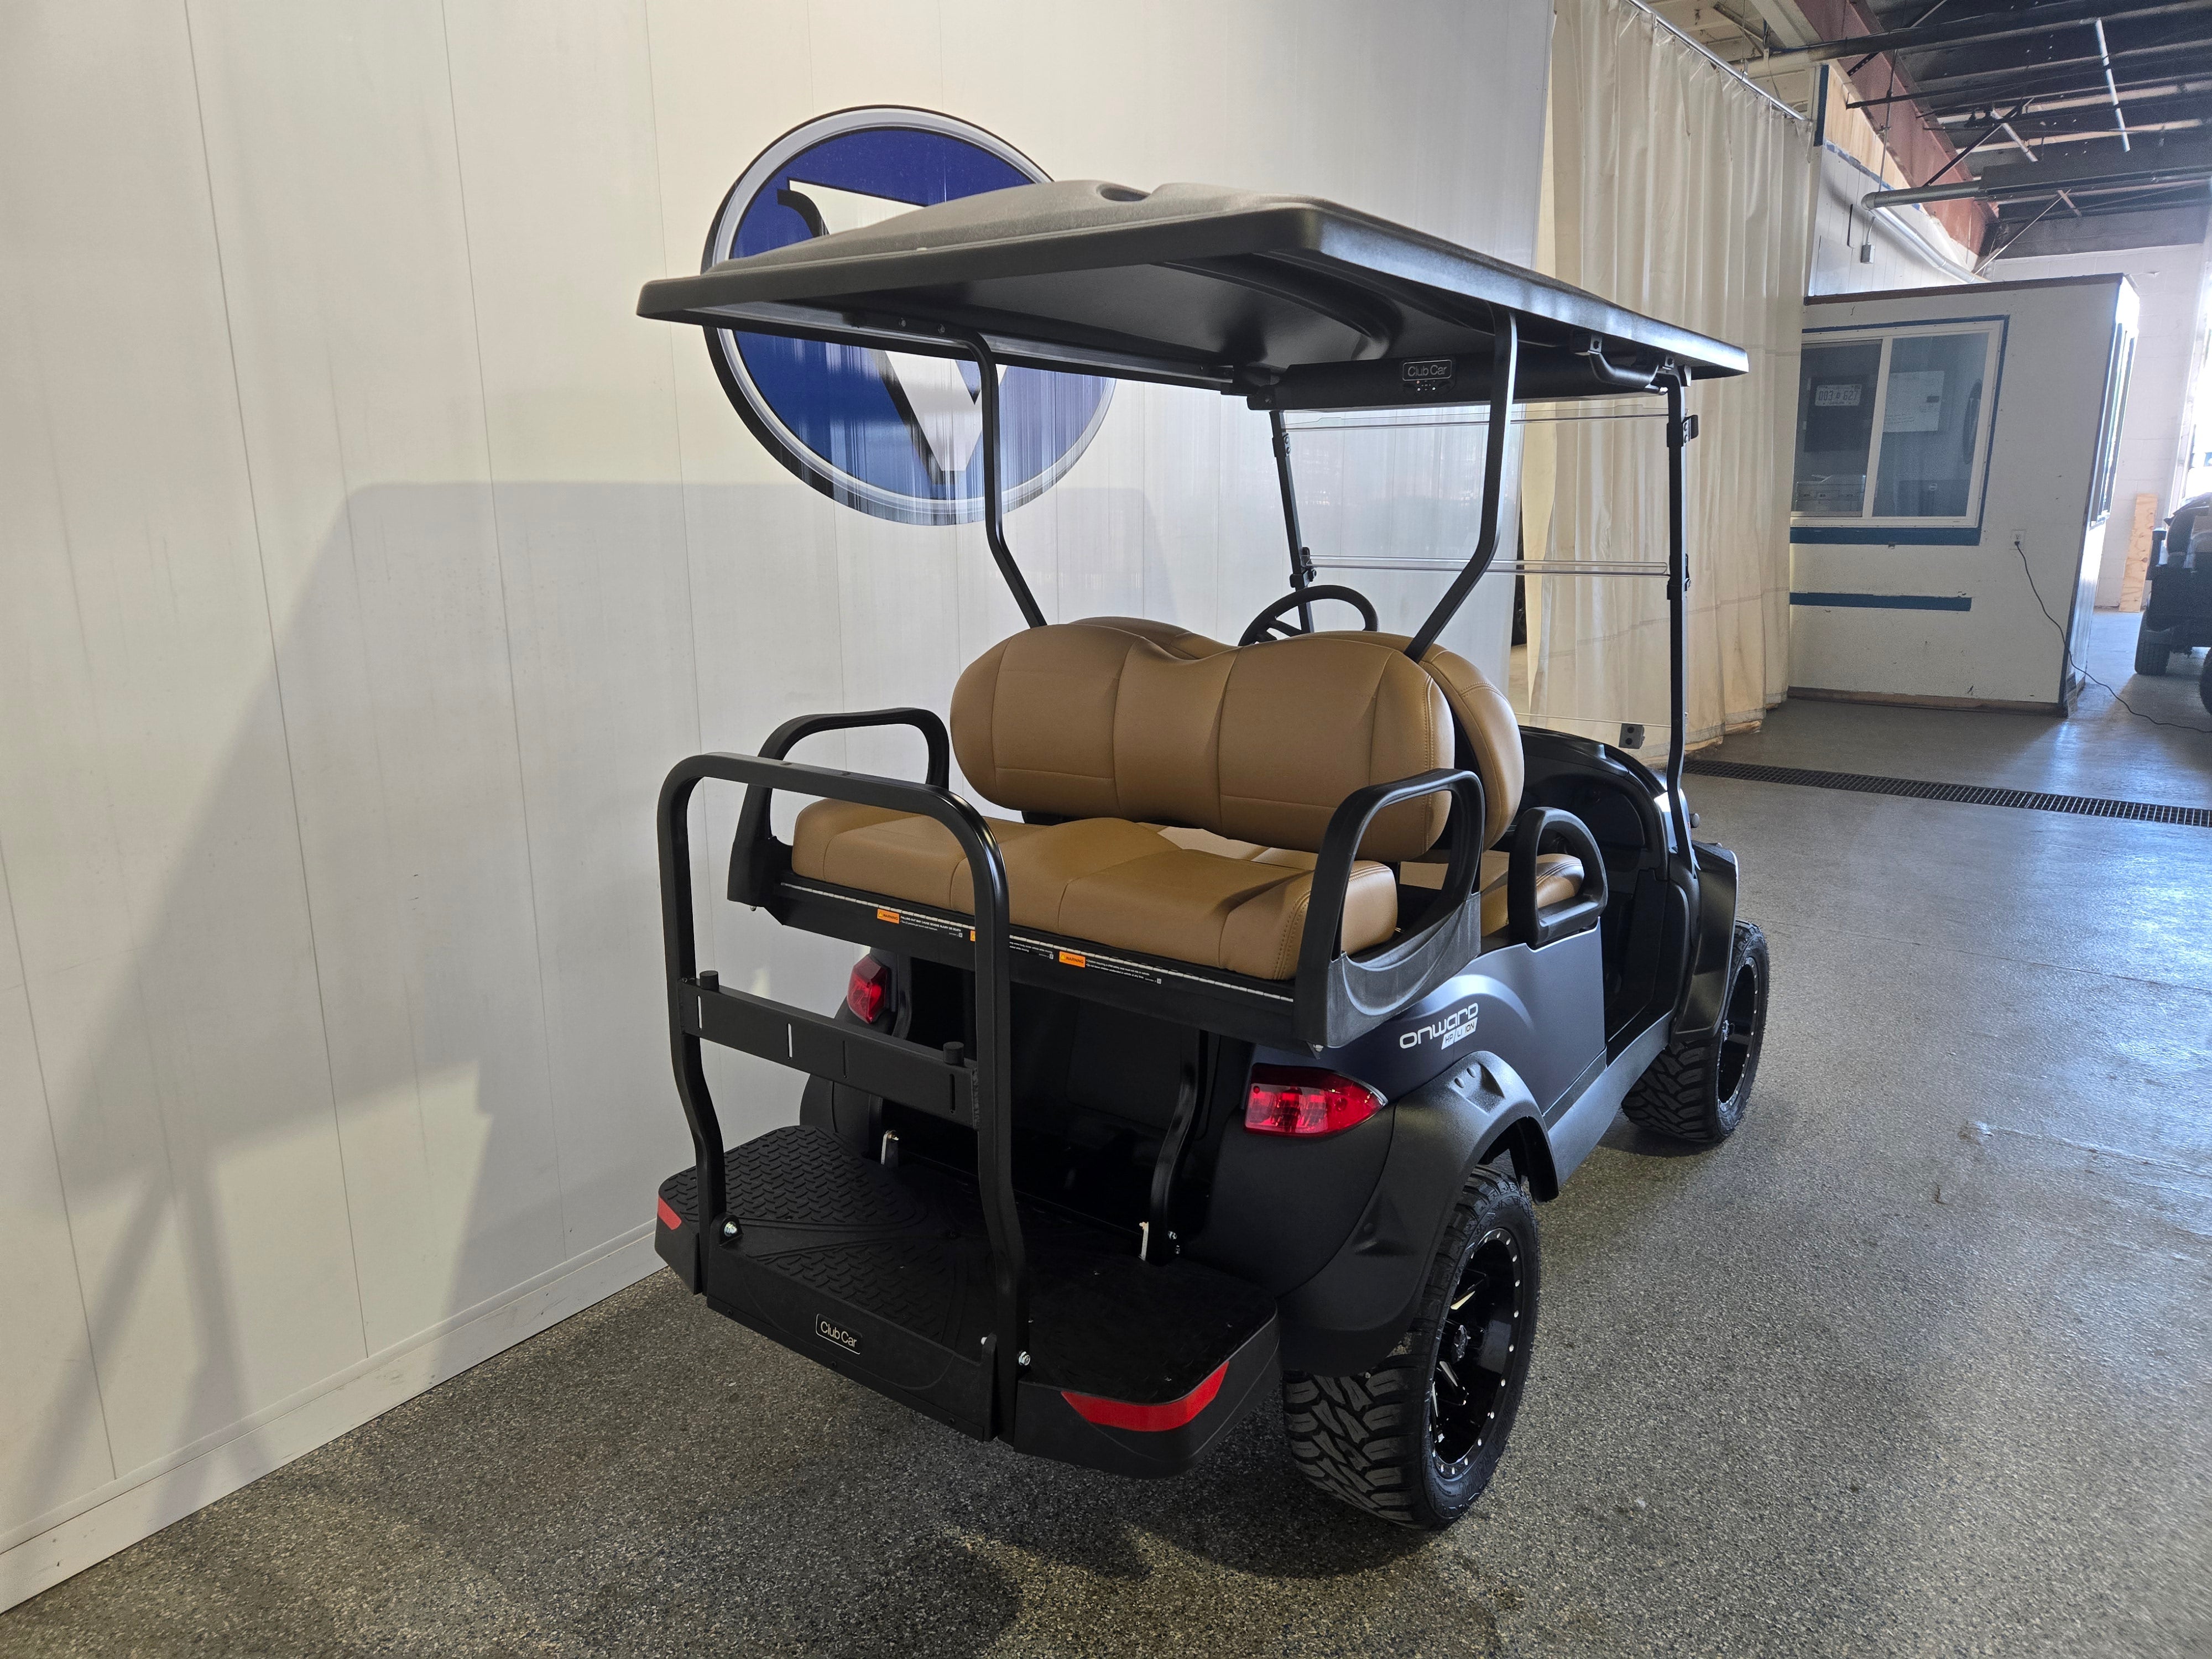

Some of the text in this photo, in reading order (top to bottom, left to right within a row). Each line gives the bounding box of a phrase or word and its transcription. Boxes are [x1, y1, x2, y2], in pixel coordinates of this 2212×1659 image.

[1407, 364, 1447, 377] Club Car
[1445, 1034, 1453, 1044] HP
[821, 1321, 857, 1348] Club Car
